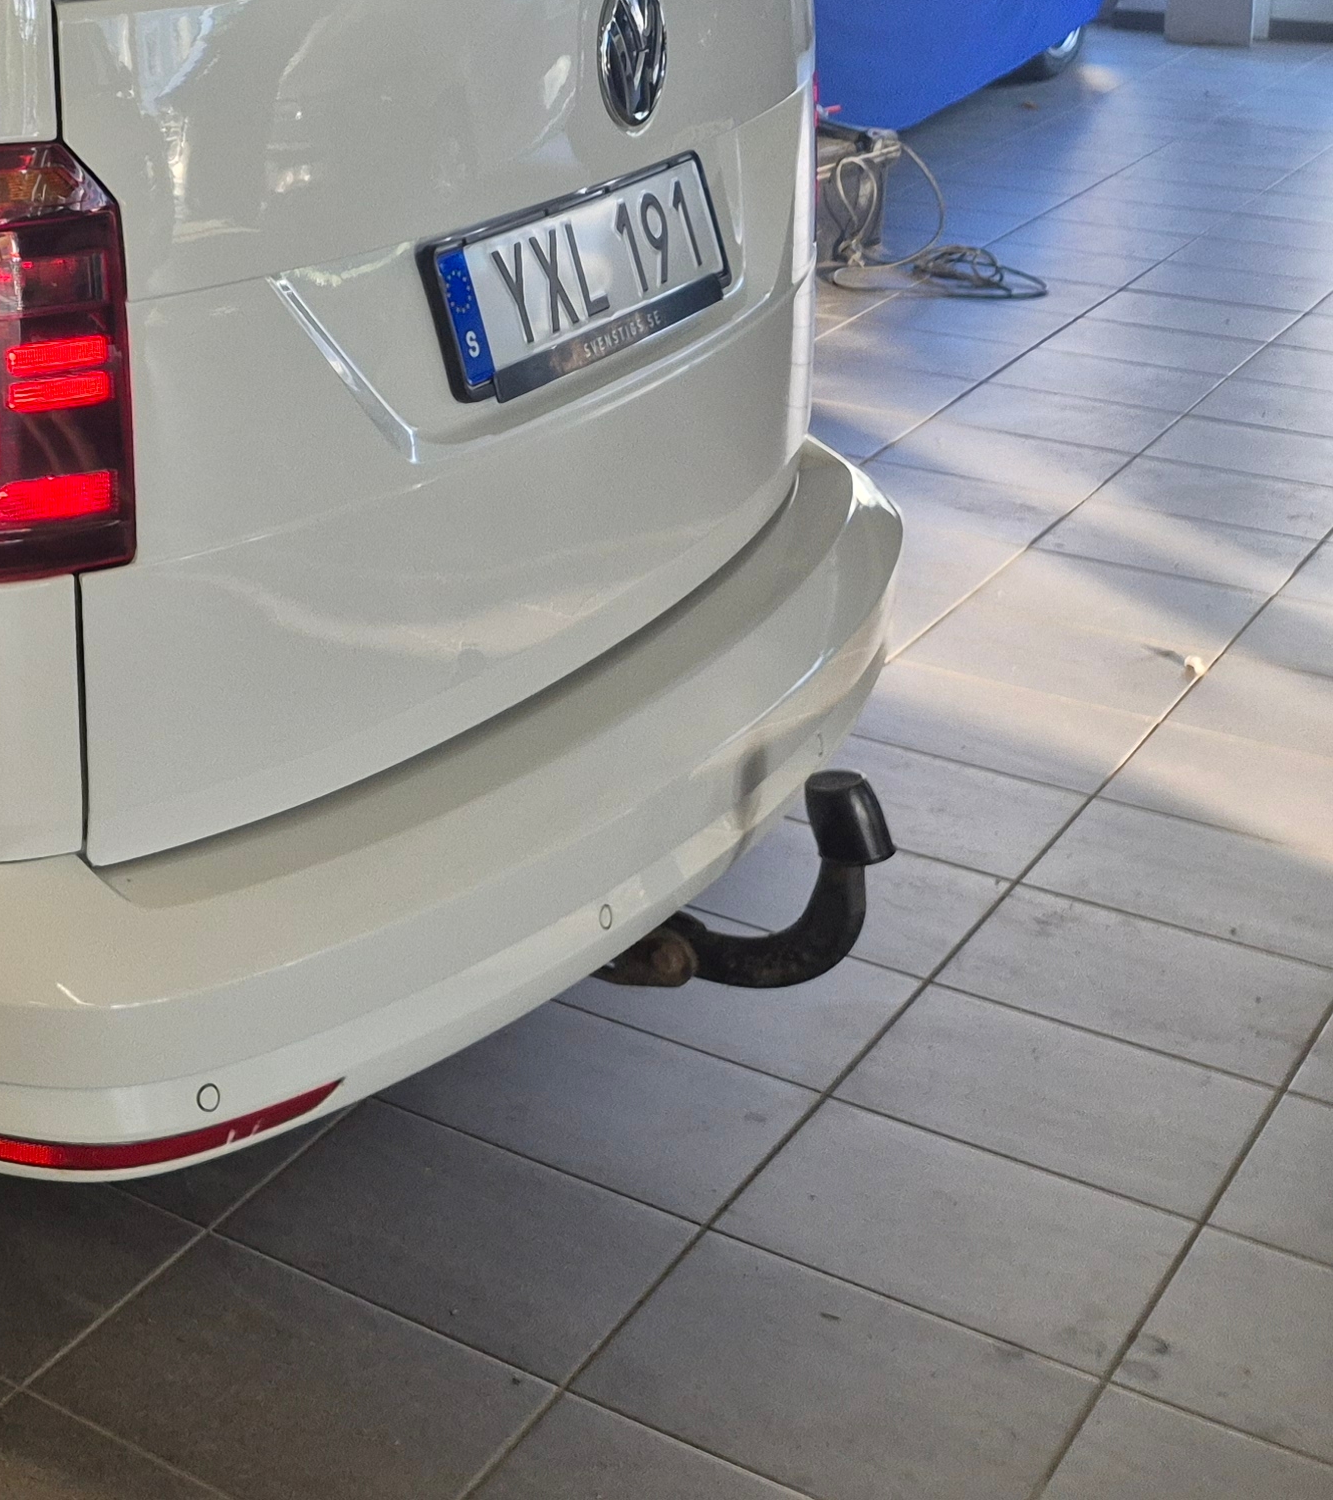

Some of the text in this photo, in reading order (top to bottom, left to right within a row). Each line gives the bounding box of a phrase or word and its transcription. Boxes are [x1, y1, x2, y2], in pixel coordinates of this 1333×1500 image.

[491, 179, 703, 343] YXL 191
[465, 331, 480, 358] S
